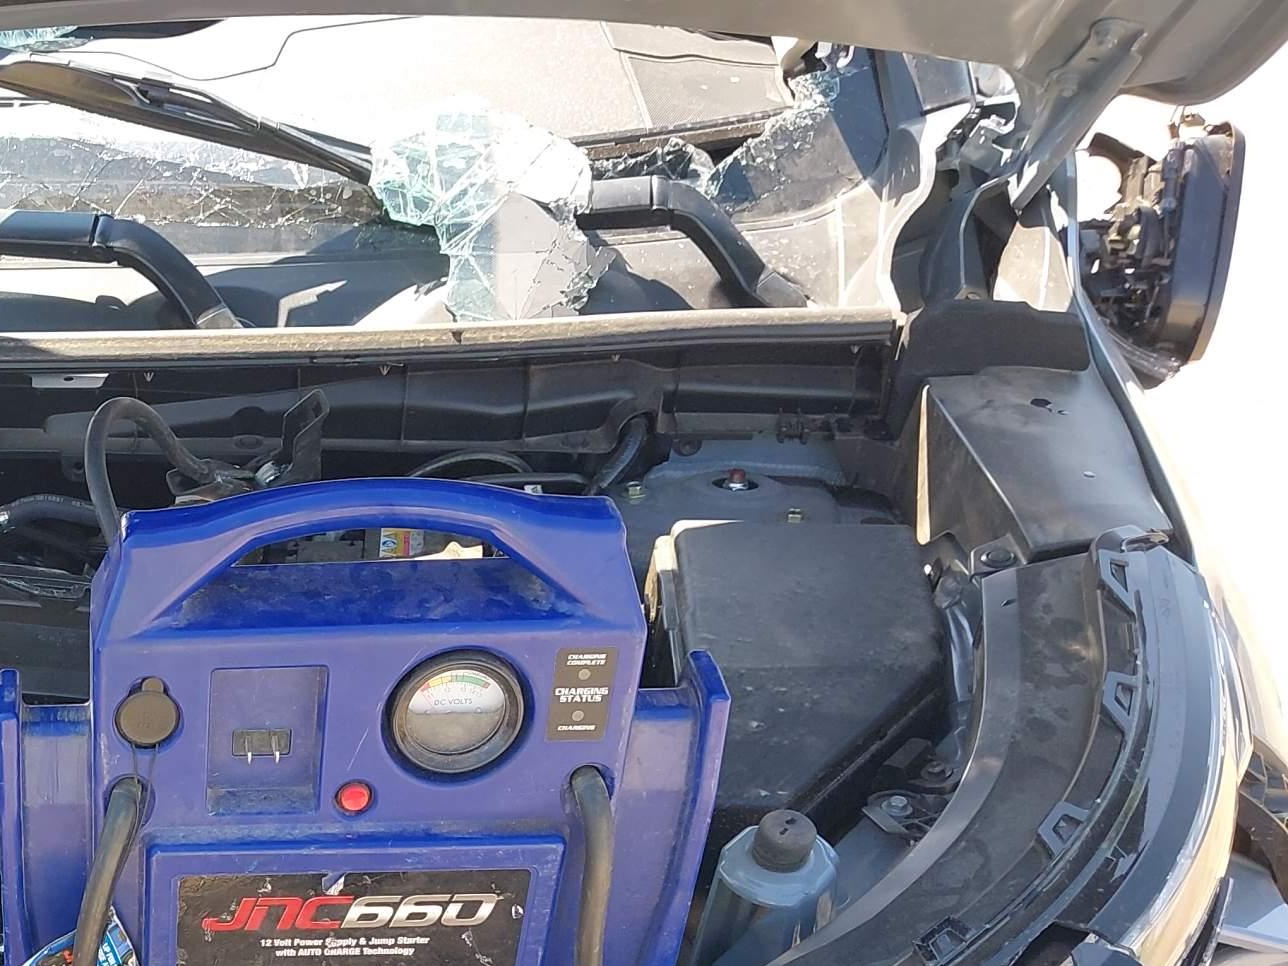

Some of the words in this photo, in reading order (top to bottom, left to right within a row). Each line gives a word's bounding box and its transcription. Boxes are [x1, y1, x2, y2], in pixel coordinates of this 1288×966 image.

[554, 687, 609, 696] CHARGING
[447, 697, 473, 705] VOLTS
[559, 694, 602, 703] STATUS
[201, 893, 504, 931] JNC660
[260, 938, 272, 947] 12
[273, 938, 292, 947] Volt
[293, 938, 323, 946] Power
[358, 937, 367, 946] &
[368, 936, 395, 946] Jump
[396, 936, 431, 945] Starter
[275, 948, 297, 957] with
[297, 948, 322, 956] AUTO
[323, 947, 361, 956] CHARGE
[362, 946, 416, 956] Technology
